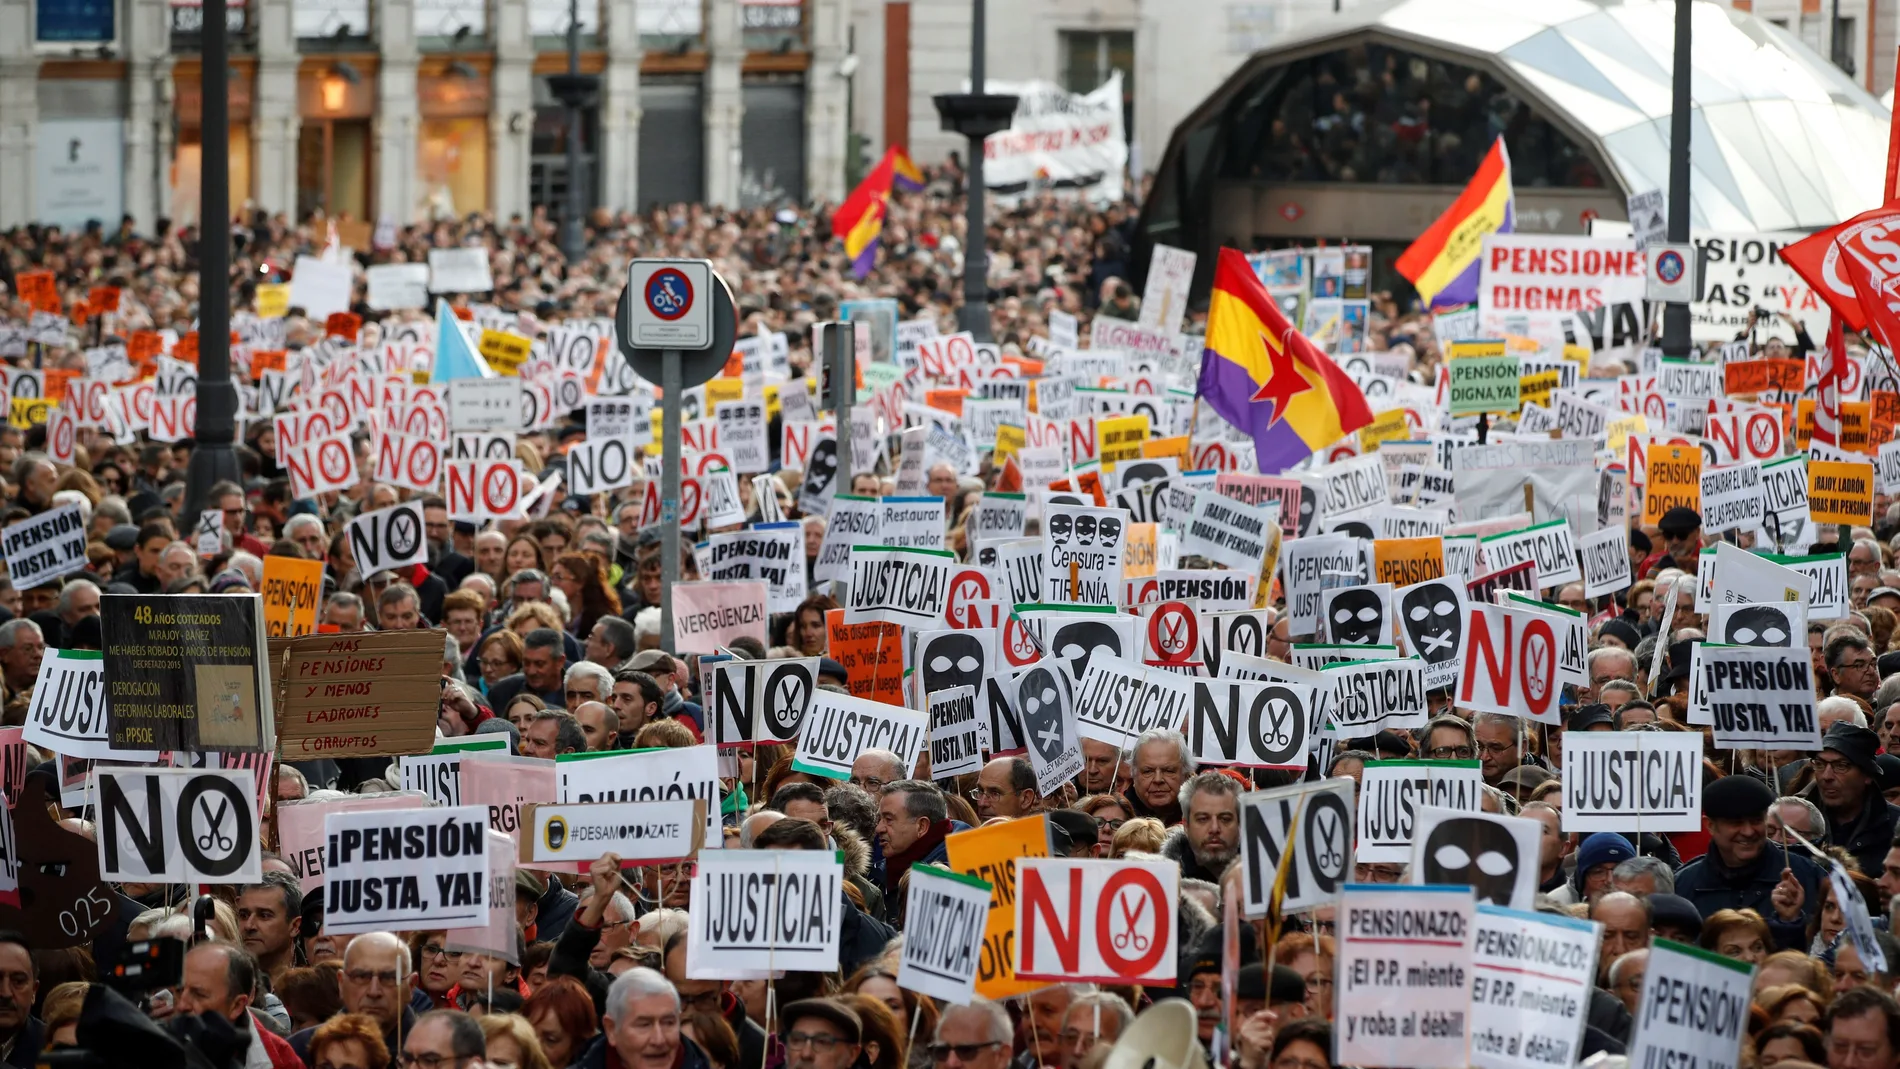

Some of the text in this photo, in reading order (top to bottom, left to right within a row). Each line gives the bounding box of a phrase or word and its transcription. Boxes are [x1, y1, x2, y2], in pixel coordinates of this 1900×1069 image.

[1695, 237, 1790, 267] SION
[1492, 286, 1605, 313] DIGNAS
[548, 331, 593, 370] NO
[920, 337, 974, 379] NO
[1453, 364, 1518, 384] ¡PENSIÓN
[1711, 413, 1780, 461] NO
[287, 440, 351, 498] NO
[378, 433, 439, 486] NO
[570, 439, 628, 494] NO
[1649, 460, 1700, 488] ¡PENSIÓN
[448, 463, 518, 514] NO
[1325, 464, 1386, 514] USTICIA!
[1701, 464, 1759, 496] RESTAURAR EL VALOR
[1762, 467, 1809, 511] TICIA!
[1814, 474, 1867, 495] ¡RAJOY, LADRÓN,
[882, 506, 940, 528] ¡Restaurar
[1704, 510, 1714, 526] DE
[1830, 499, 1840, 515] MI
[1840, 497, 1871, 518] PENSIÓN!
[5, 507, 83, 555] ¡PENSIÓN
[350, 506, 422, 575] NO
[883, 532, 940, 547] en su valor
[1191, 520, 1217, 542] ROBAS
[1217, 529, 1228, 545] MI
[1227, 531, 1264, 561] PENSIÓN!
[11, 537, 87, 580] JUSTA, YA!
[712, 539, 791, 566] ¡PENSIÓN
[1050, 544, 1104, 572] Censura
[1447, 545, 1475, 581] STICIA!
[1583, 537, 1630, 586] ¡JUSTICIA!
[759, 566, 786, 586] YA!
[851, 560, 948, 614] ¡JUSTICIA!
[1050, 575, 1113, 606] TIRANÍA.
[1160, 576, 1247, 602] ¡PENSIÓN
[134, 605, 221, 625] 48 AÑOS COTIZADOS
[677, 603, 764, 638] ¡VERGÜENZA!
[832, 622, 897, 642] Nos discrimnan
[109, 644, 251, 658] ME HABÉIS ROBADO 2 AÑOS DE PENSIÓN
[329, 639, 361, 654] MAS
[843, 652, 856, 668] los
[1461, 609, 1556, 715] NO
[133, 660, 181, 670] DECRETAZO 2015
[1705, 656, 1809, 694] ¡PENSIÓN
[112, 680, 161, 696] DEROGACIÓN
[324, 681, 372, 698] MENOS
[715, 662, 813, 743] NO
[876, 679, 901, 697] luego!
[1076, 666, 1187, 734] ¡JUSTICIA!
[114, 705, 195, 719] REFORMAS LABORALES
[306, 705, 381, 724] LADRONES
[930, 695, 976, 733] ¡PENSIÓN
[1194, 682, 1305, 764] NO
[1713, 703, 1815, 735] JUSTA, YA!
[116, 727, 154, 744] DEL PPSOE
[301, 736, 377, 752] CORRUPTOS
[802, 704, 920, 769] ¡JUSTICIA!
[931, 730, 978, 766] JUSTA, YA!
[1037, 746, 1079, 780] LA LEY MORDAZA,
[1568, 749, 1695, 811] ¡JUSTICIA!
[1041, 771, 1068, 795] DICTADURA
[99, 774, 253, 877] NO
[327, 817, 484, 868] ¡PENSIÓN
[570, 821, 680, 842] #DESAMORDÁZATE
[1244, 790, 1352, 906] NO
[326, 871, 483, 914] JUSTA, YA!
[58, 886, 112, 938] 0,25
[1020, 867, 1170, 979] NO
[1349, 908, 1467, 938] PENSIONAZO:
[905, 885, 985, 977] ¡JUSTICIA!
[1475, 926, 1589, 971] PENSIONAZO:
[1375, 959, 1401, 988] P.P.
[1406, 961, 1466, 988] miente
[1492, 980, 1515, 1008] P.P.
[1518, 985, 1578, 1019] miente
[1643, 975, 1744, 1041] ¡PENSIÓN
[1346, 1014, 1357, 1042] y
[1361, 1010, 1396, 1037] roba
[1401, 1010, 1416, 1037] al
[1510, 1034, 1523, 1053] al
